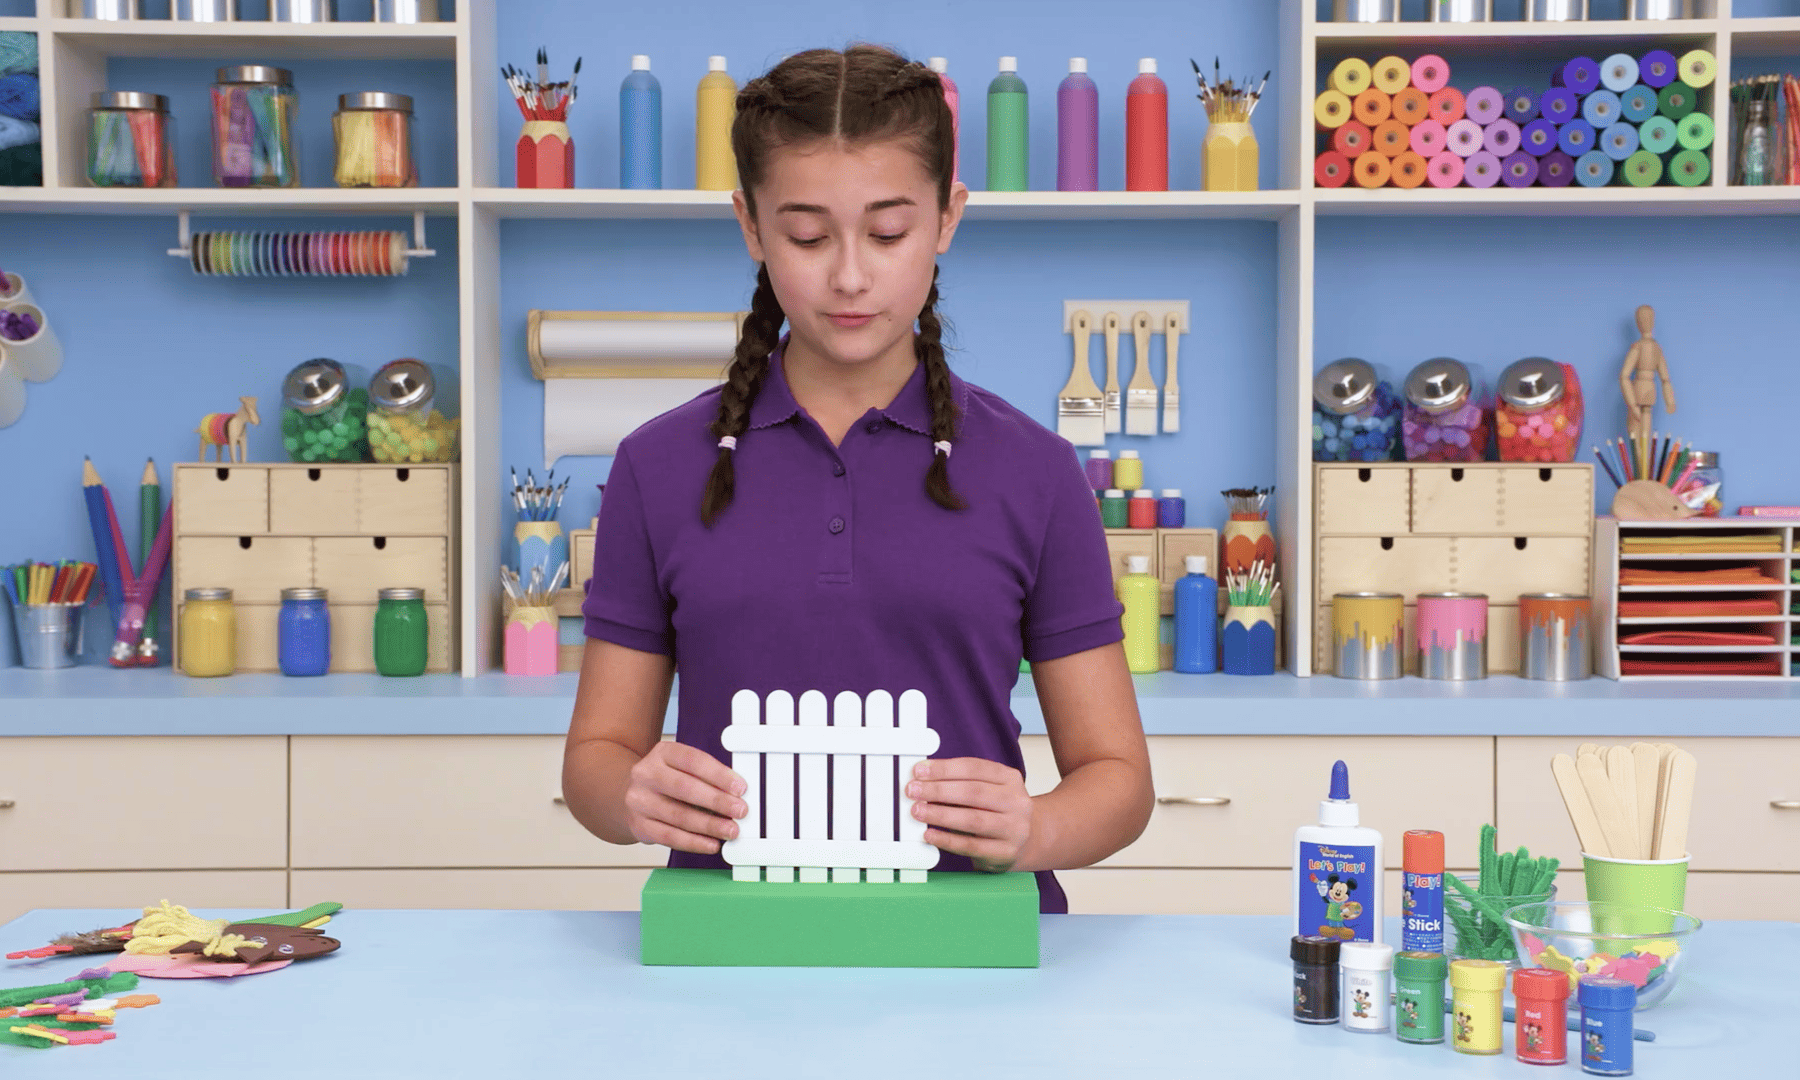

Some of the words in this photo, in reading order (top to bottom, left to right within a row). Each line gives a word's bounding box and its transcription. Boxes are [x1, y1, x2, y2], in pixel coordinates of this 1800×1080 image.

[1308, 859, 1334, 872] Let's
[1336, 861, 1366, 875] Play!
[1407, 873, 1441, 890] Play!
[1408, 918, 1441, 932] Stick
[1525, 1009, 1541, 1020] Red
